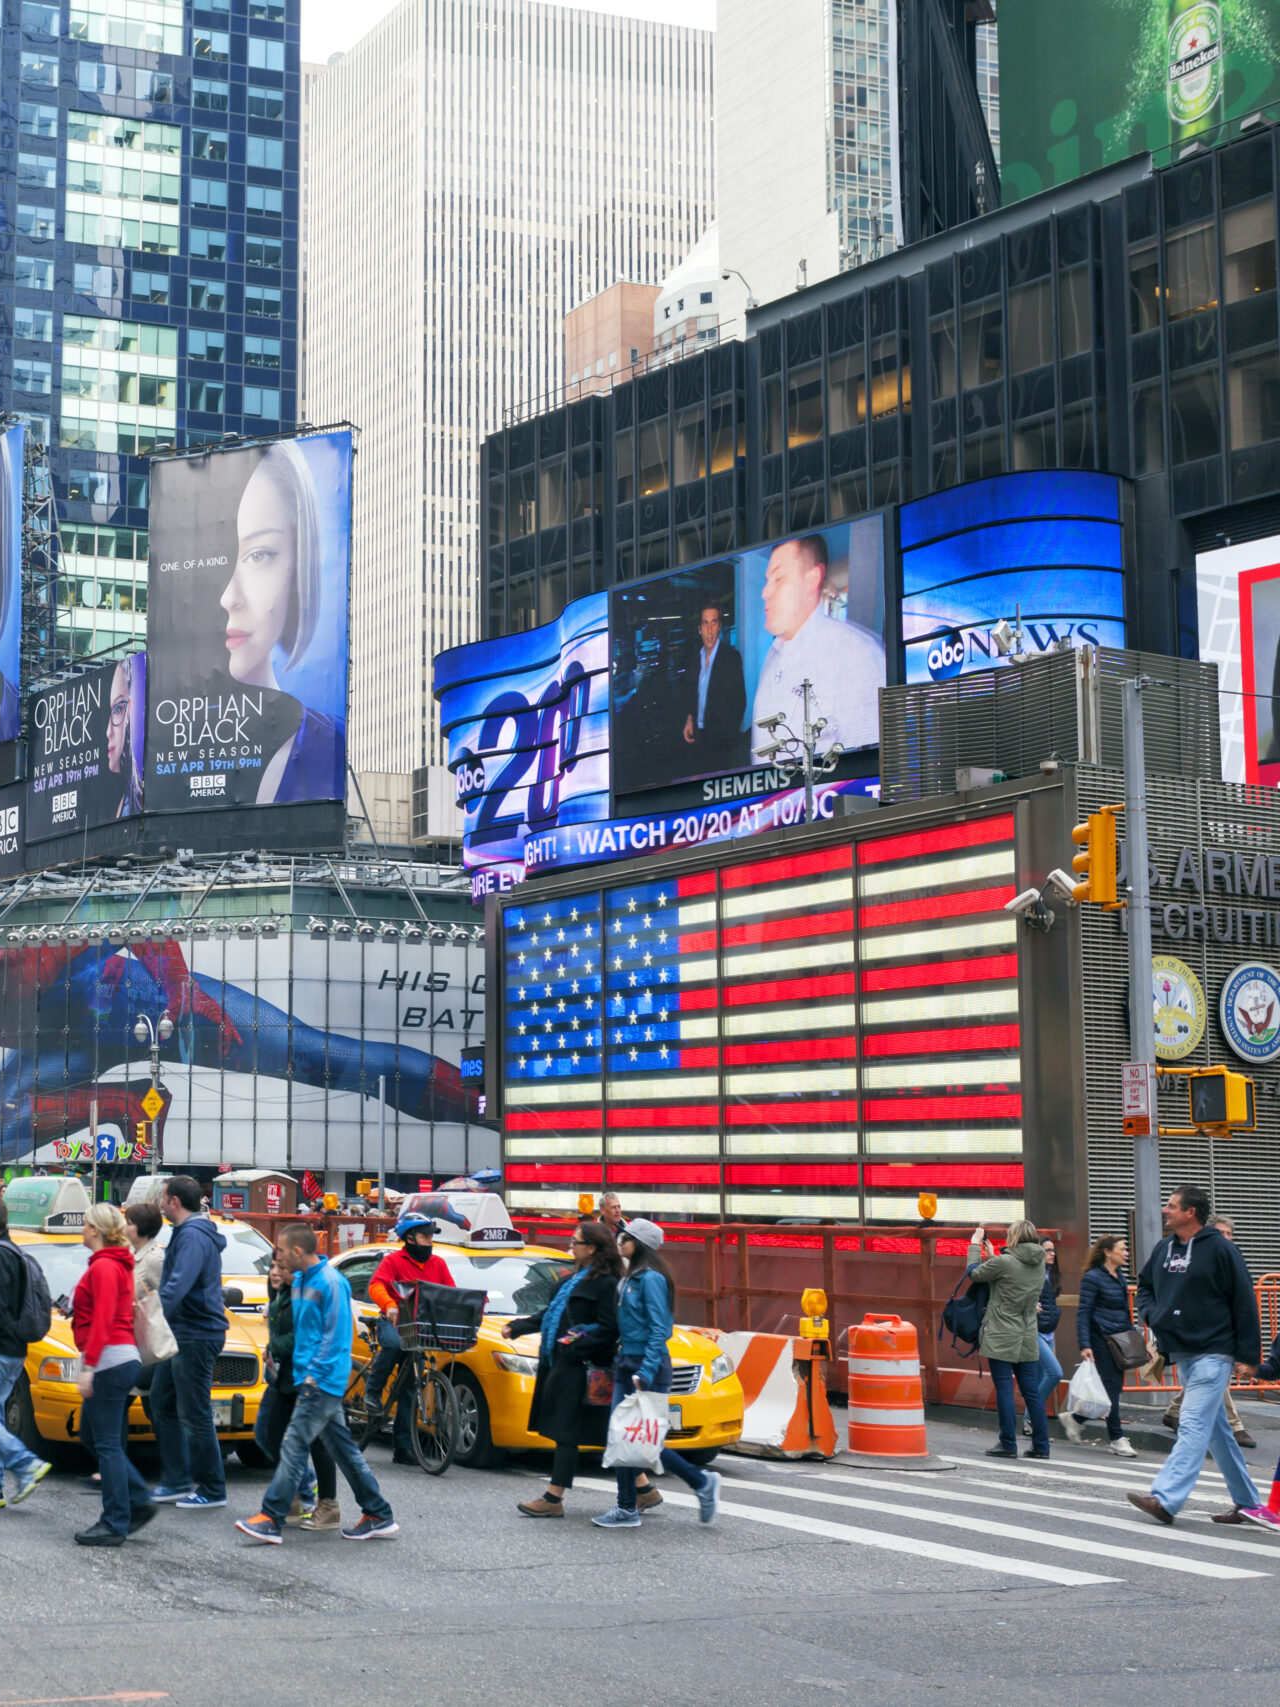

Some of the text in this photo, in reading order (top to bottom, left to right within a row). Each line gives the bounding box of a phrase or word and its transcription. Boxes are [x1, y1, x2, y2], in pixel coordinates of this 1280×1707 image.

[1170, 46, 1219, 78] Heineken
[183, 560, 197, 570] OF
[197, 559, 204, 568] A
[206, 556, 228, 567] KIND.
[928, 623, 1099, 670] abc NWS
[34, 678, 101, 729] ORPHAN
[156, 691, 262, 724] ORPHAN
[44, 711, 92, 755] BLACK
[173, 716, 250, 747] BLACK
[34, 747, 100, 778] NEW SEASON
[156, 744, 262, 762] NEW SEASON
[156, 757, 262, 775] SAT APR 19TH 9PM
[33, 779, 47, 793] SAT
[48, 772, 63, 789] APR
[66, 768, 81, 785] 19TH
[190, 774, 226, 789] BBC
[190, 787, 225, 798] AMERICA
[703, 770, 790, 801] SIEMENS
[52, 790, 77, 813] BBC
[52, 809, 77, 824] AMERICA
[577, 819, 667, 855] WATCH
[673, 809, 732, 843] 20/20
[736, 803, 764, 832] AT
[1173, 846, 1280, 898] ARME
[378, 970, 451, 993] HIS
[1226, 971, 1256, 1008] DEPARTMENT
[1257, 971, 1265, 979] OF
[401, 1007, 484, 1030] BAT
[1227, 1016, 1241, 1048] UNITED
[1241, 1042, 1261, 1055] STATES
[1261, 1045, 1270, 1054] OF
[1124, 1080, 1145, 1088] STOPPING
[1129, 1068, 1140, 1079] NO
[1129, 1087, 1139, 1095] ANY
[1129, 1094, 1140, 1102] TIME
[53, 1140, 93, 1160] TOYS
[96, 1133, 116, 1162] R
[482, 1228, 508, 1241] 2M87
[622, 1415, 659, 1446] H&M
